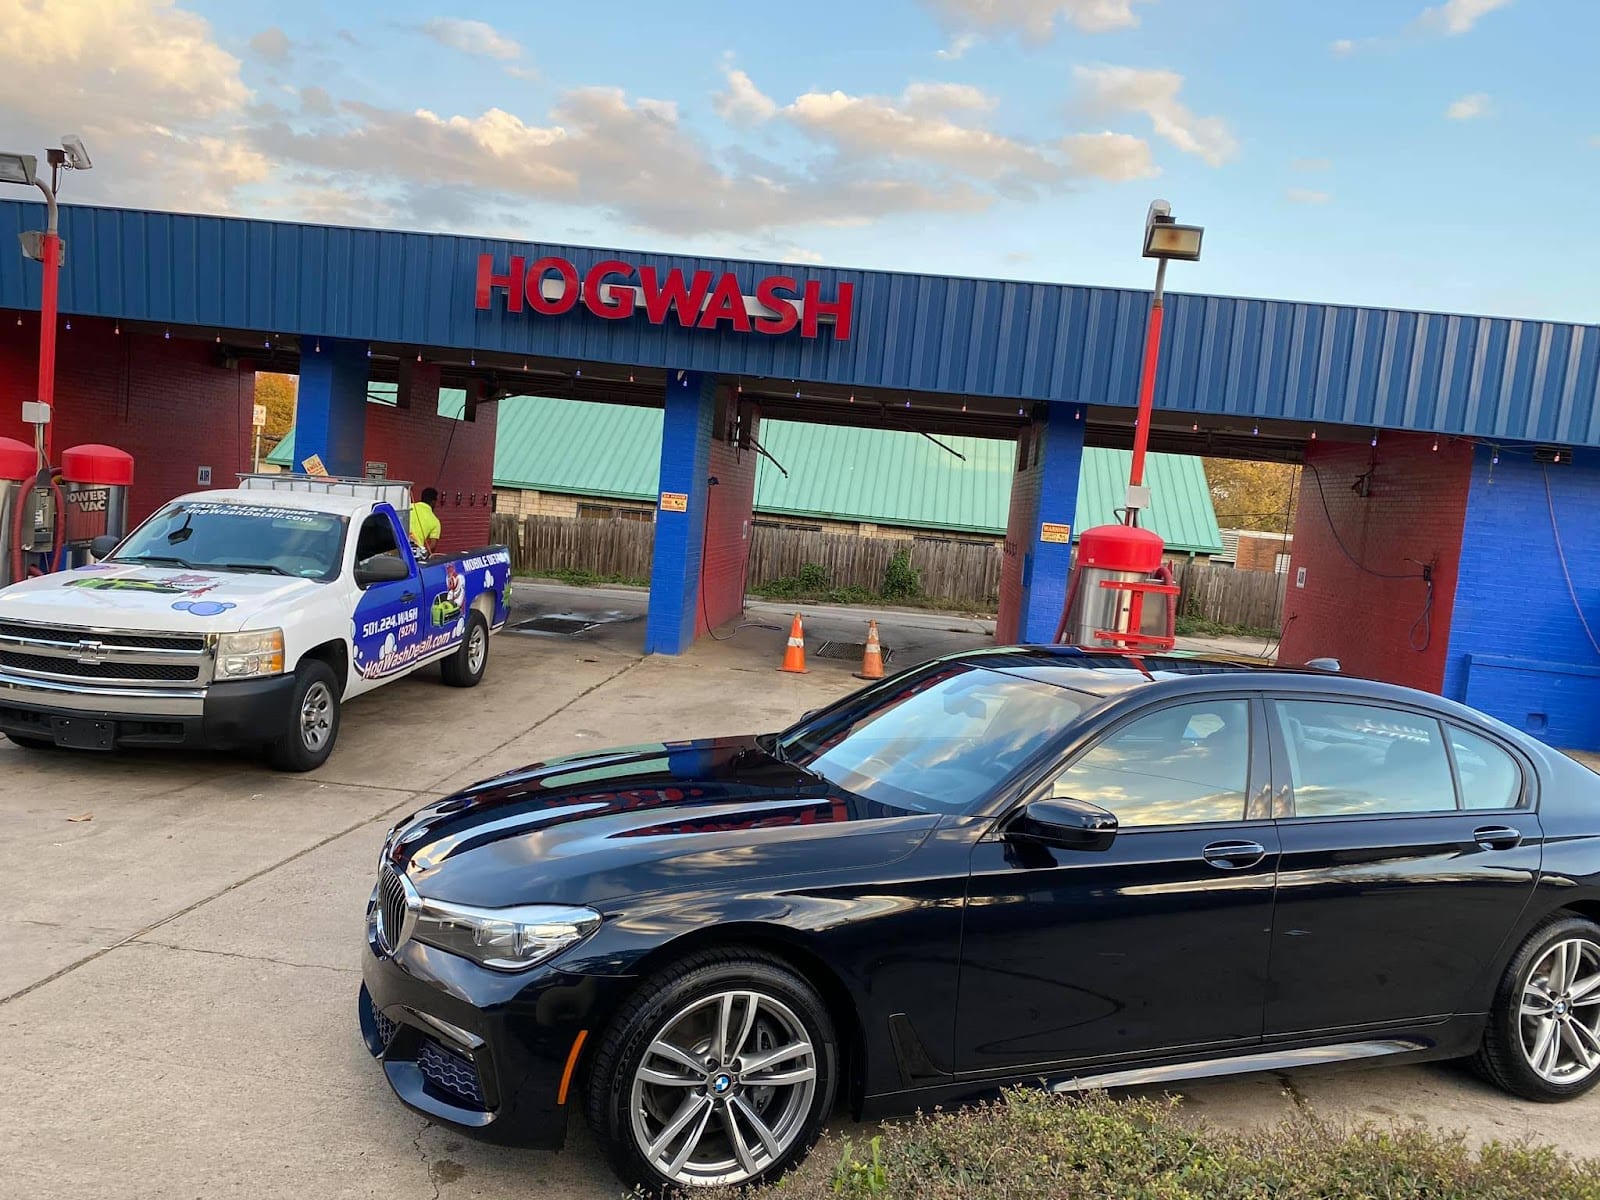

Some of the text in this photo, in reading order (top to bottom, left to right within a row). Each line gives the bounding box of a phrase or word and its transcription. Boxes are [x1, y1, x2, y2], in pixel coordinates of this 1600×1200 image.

[475, 253, 854, 341] HOGWASH
[200, 470, 210, 482] AIR
[80, 501, 106, 512] VAC
[463, 556, 489, 571] MOBILE
[398, 621, 418, 641] (9274)
